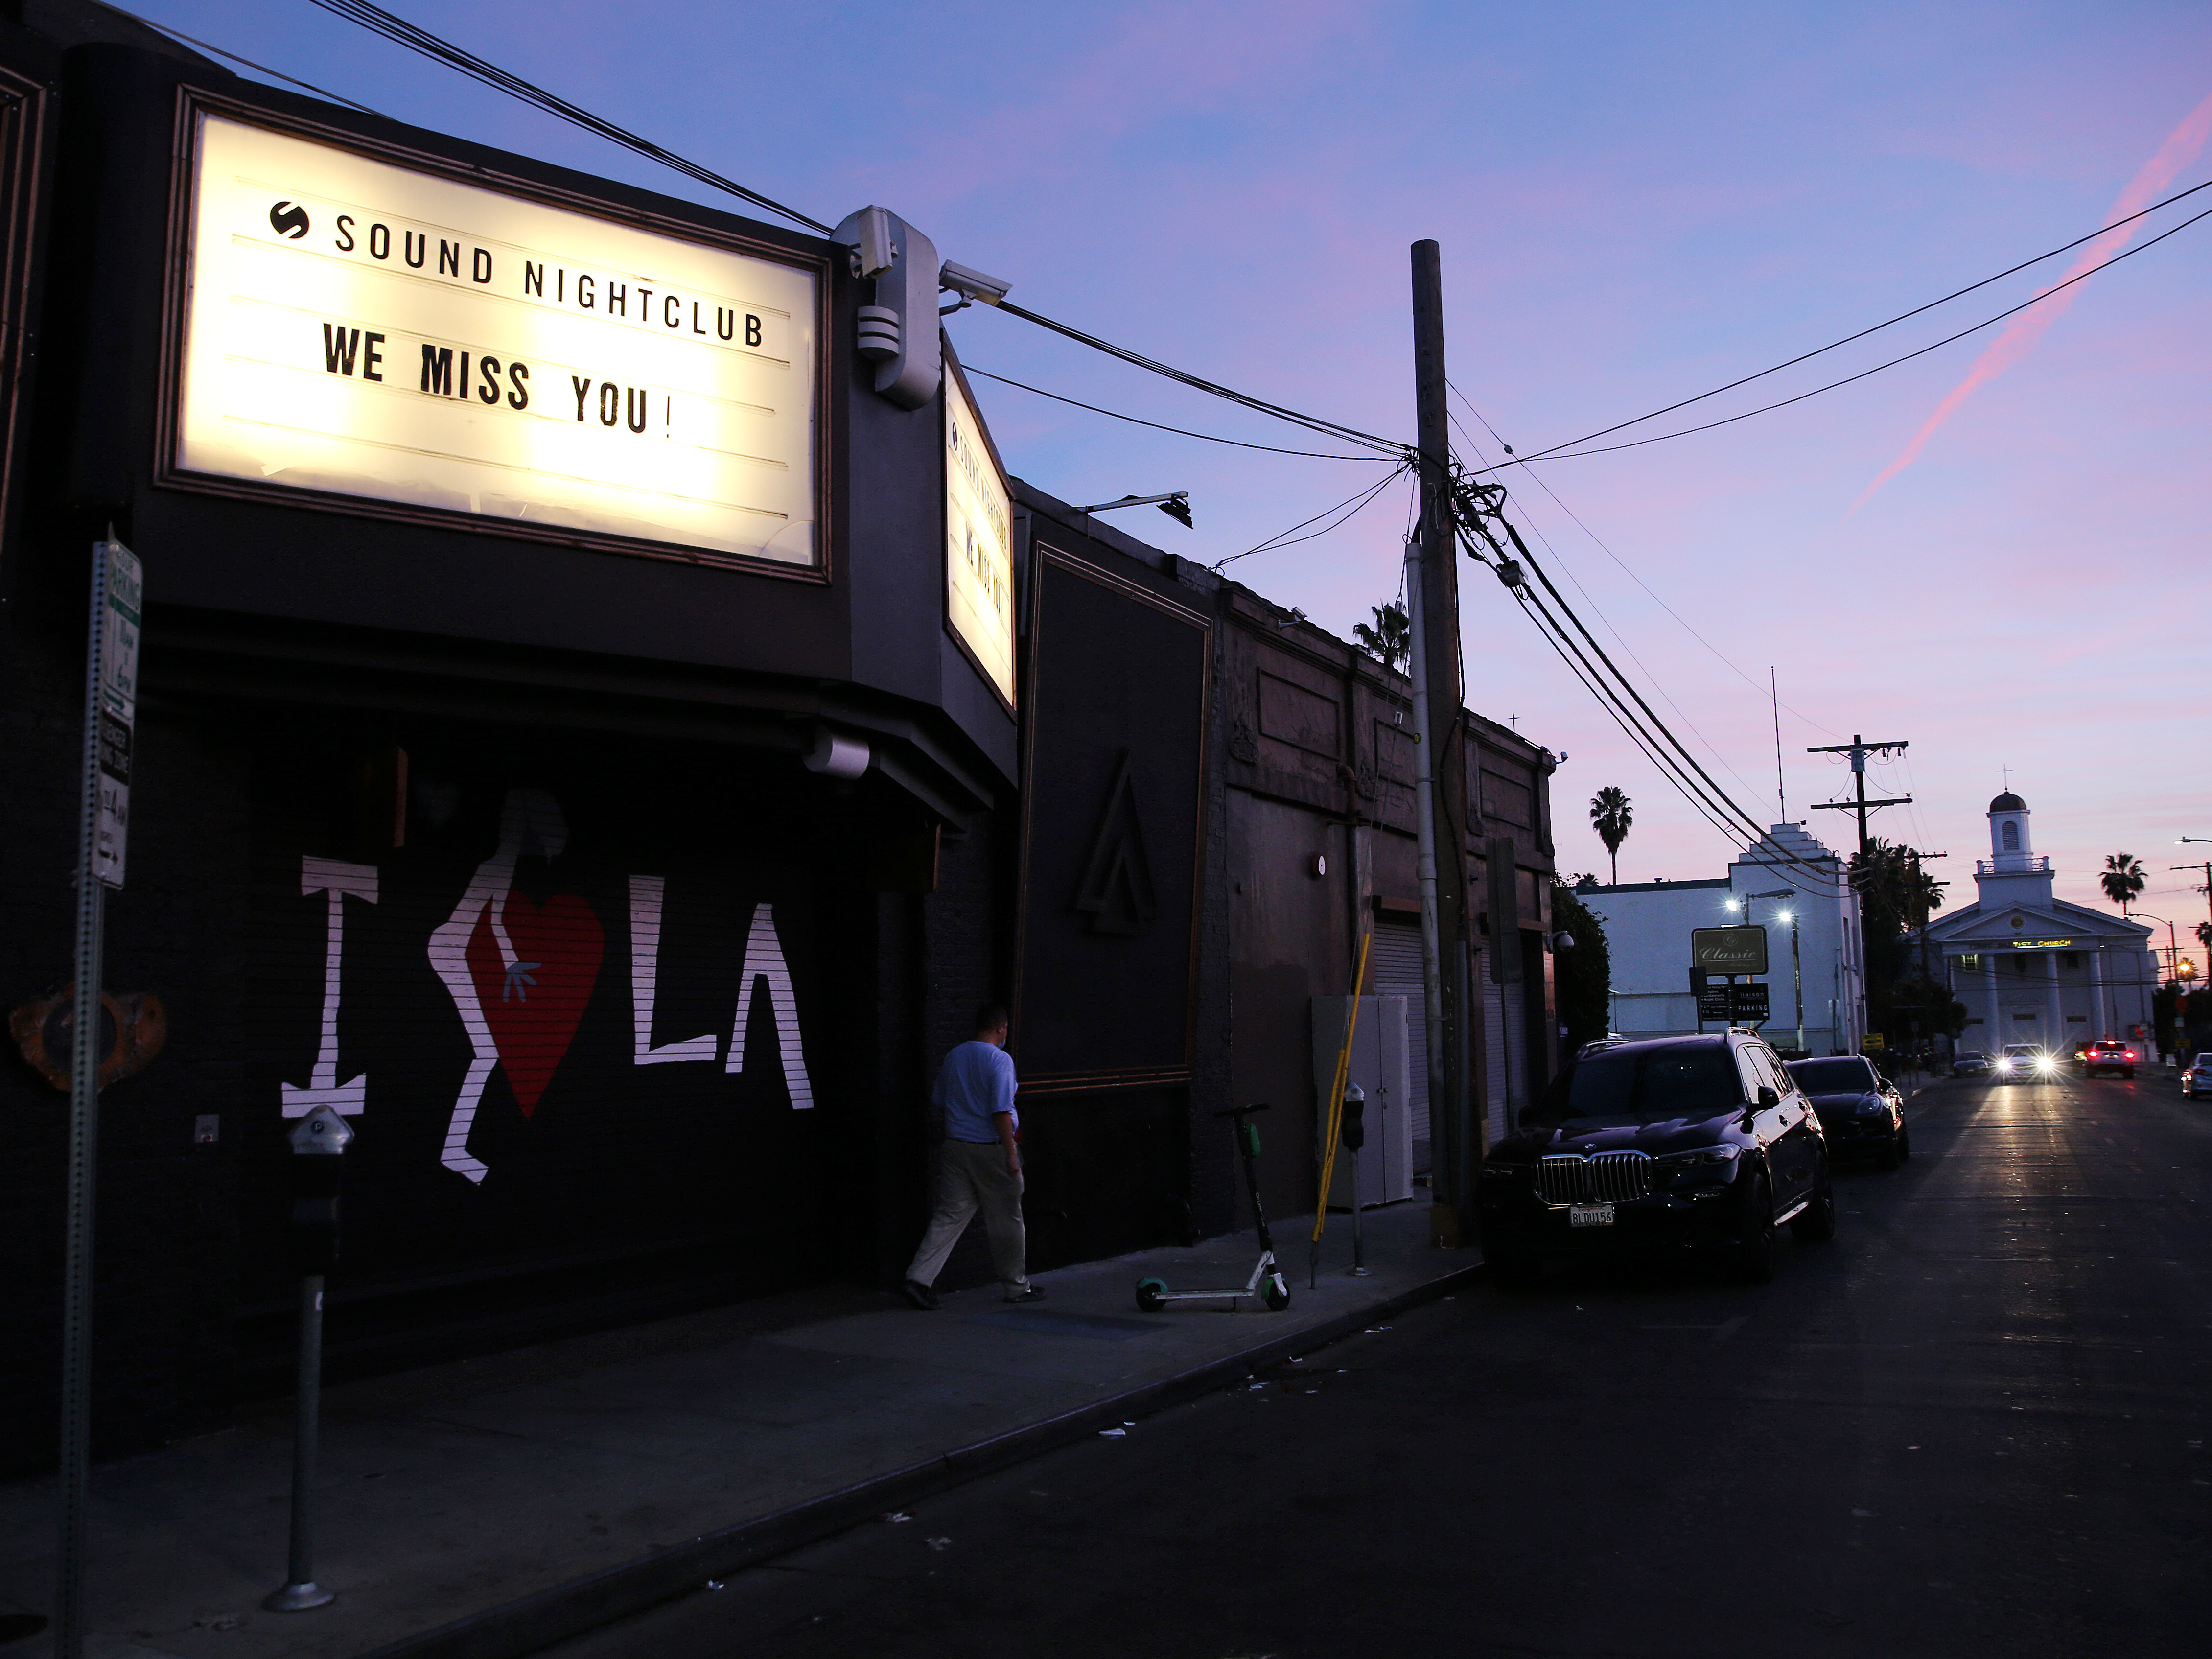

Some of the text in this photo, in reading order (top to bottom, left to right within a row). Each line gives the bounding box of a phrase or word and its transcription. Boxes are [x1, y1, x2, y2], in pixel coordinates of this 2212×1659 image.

[335, 214, 763, 347] SOUND NIGHTCLUB
[323, 323, 671, 438] WE MISS YOU!
[960, 435, 1006, 550] SOUND NIGHTCLUB
[966, 521, 973, 567] WE
[978, 543, 990, 594] MISS
[628, 874, 814, 1110] LA
[1699, 948, 1756, 959] Classic
[1572, 1212, 1612, 1223] 8LDU156
